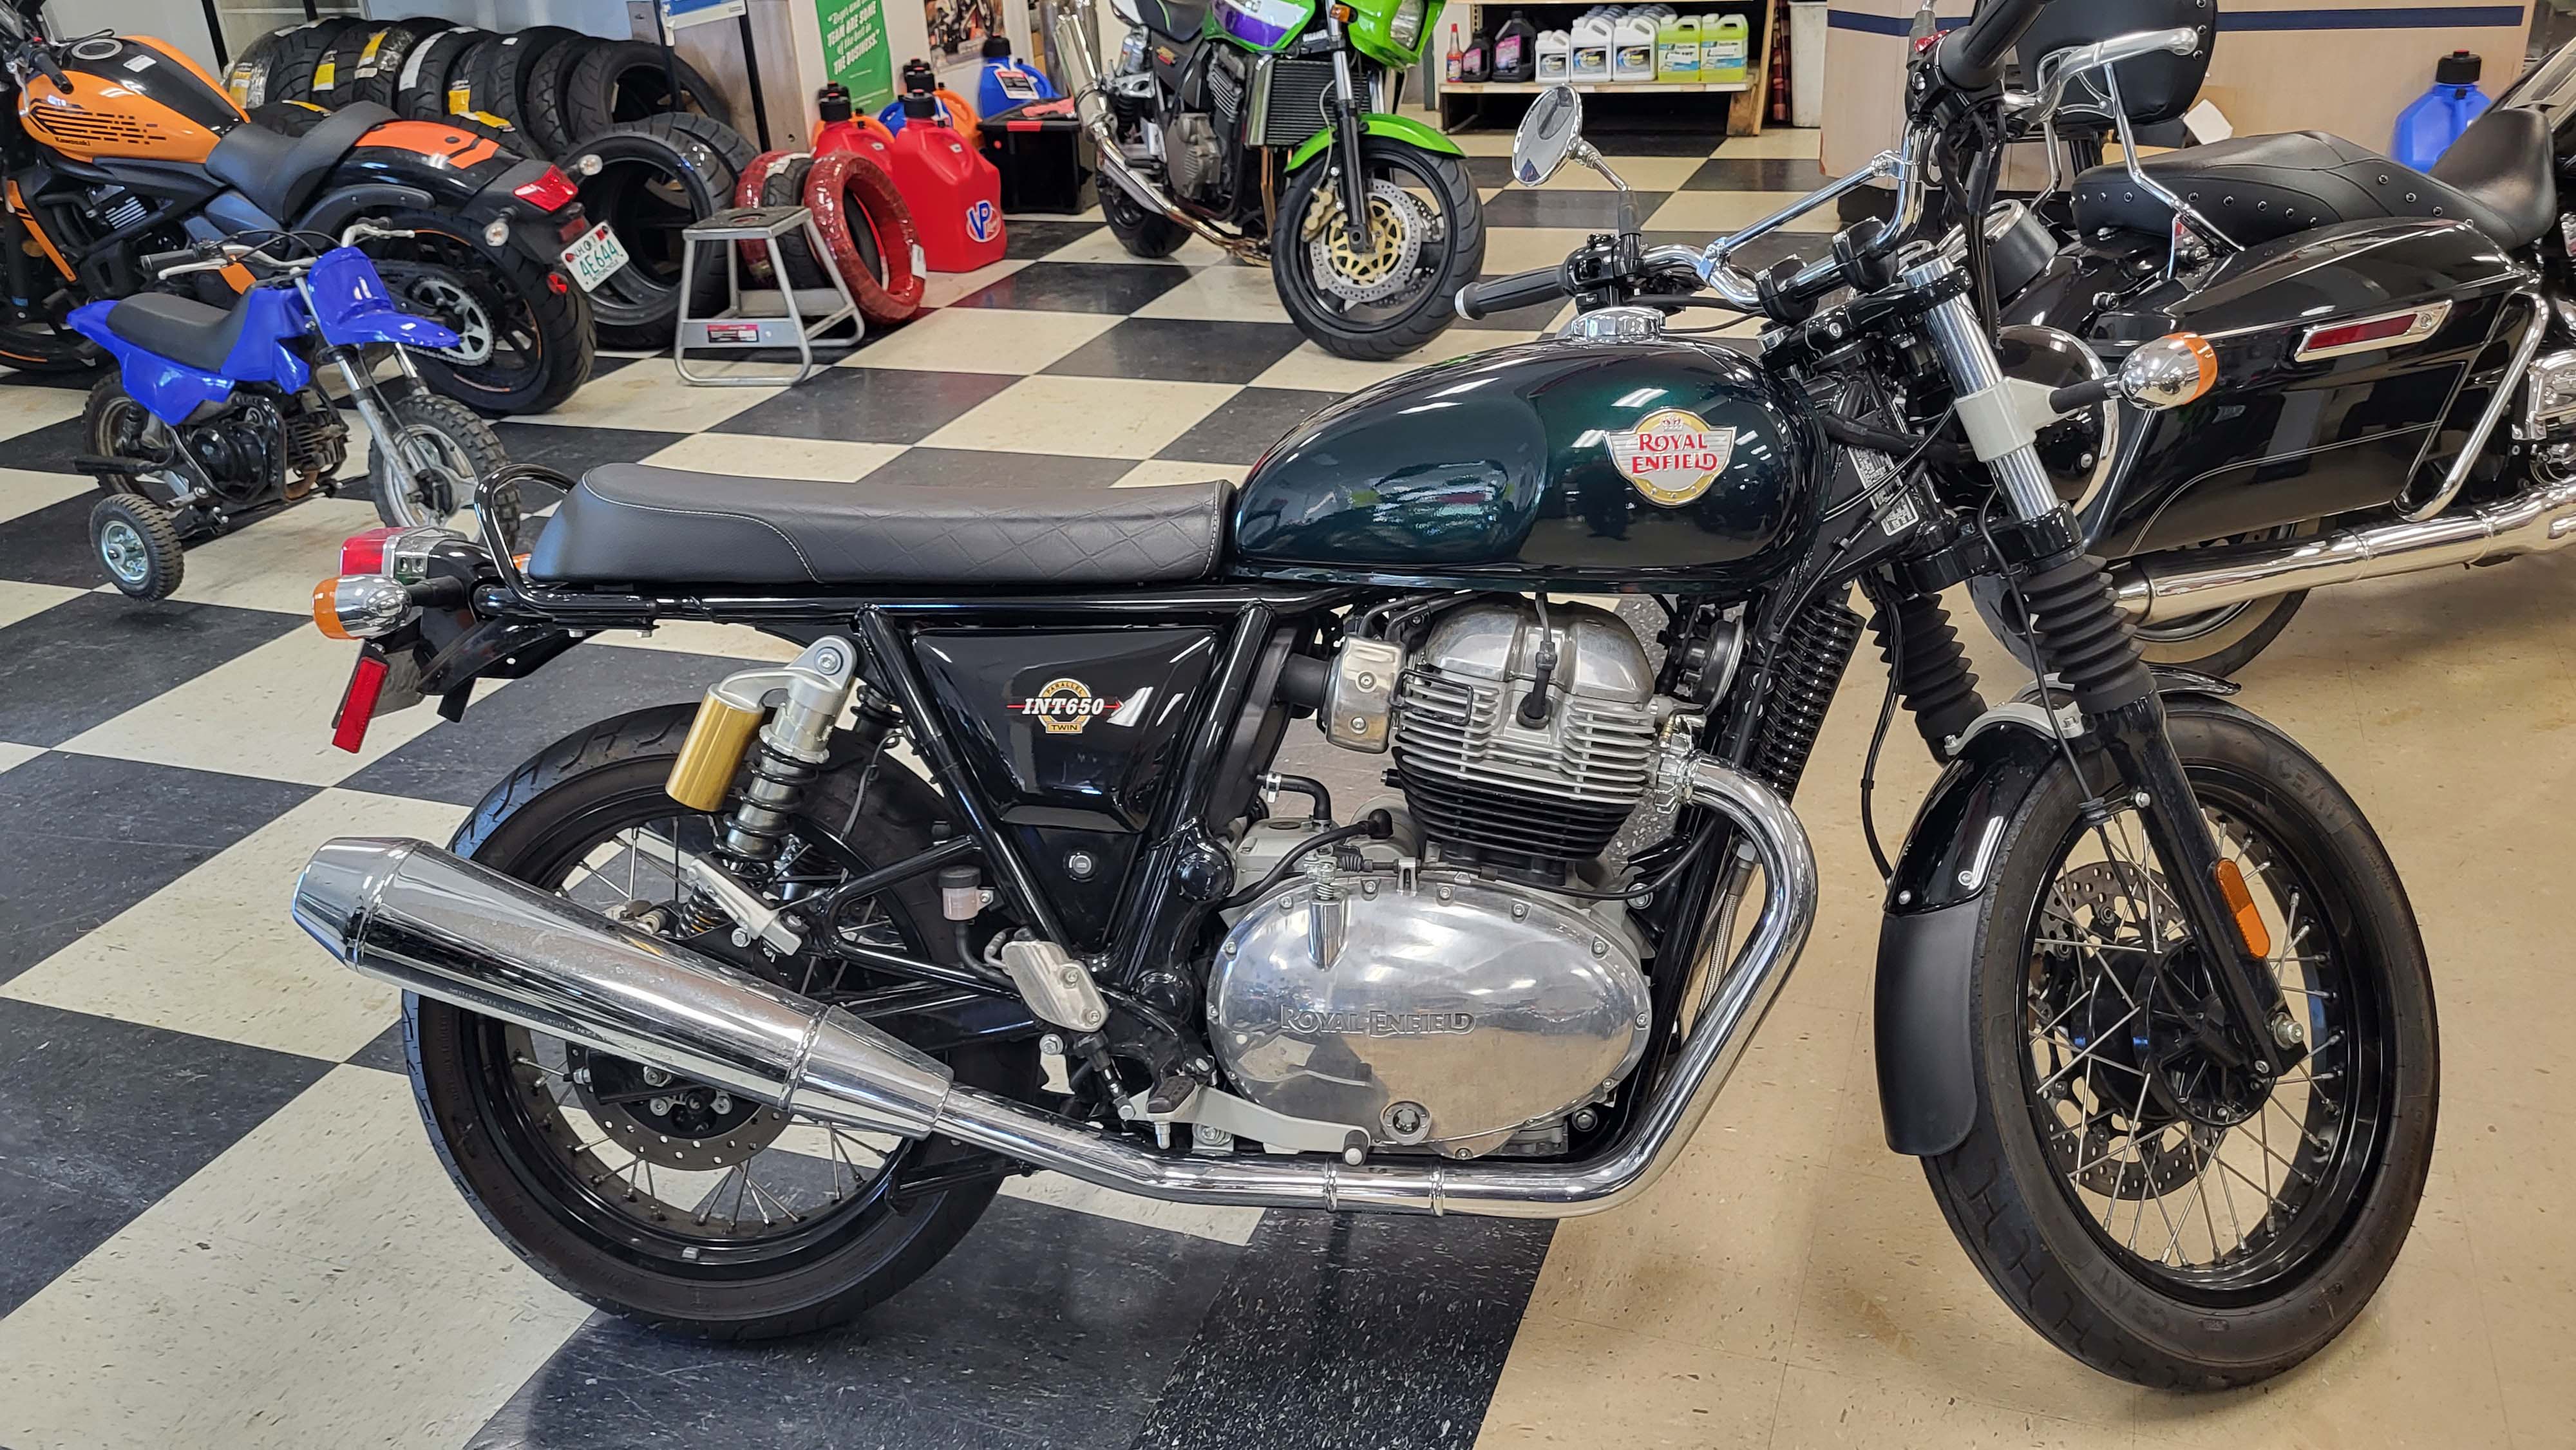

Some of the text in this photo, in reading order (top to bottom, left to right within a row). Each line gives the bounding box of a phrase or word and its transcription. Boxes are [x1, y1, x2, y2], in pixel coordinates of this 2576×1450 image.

[827, 23, 846, 48] TEAM
[846, 14, 858, 34] ARE
[859, 0, 876, 24] SOME
[833, 55, 846, 75] THE
[967, 200, 992, 241] VP
[580, 239, 620, 278] 4E644
[1639, 433, 1709, 453] ROYAL
[1631, 453, 1718, 475] ENFIELD
[1046, 681, 1083, 695] PARALLEL
[1021, 697, 1105, 715] INT650
[1281, 1004, 1477, 1039] ROYAL ENFIELD
